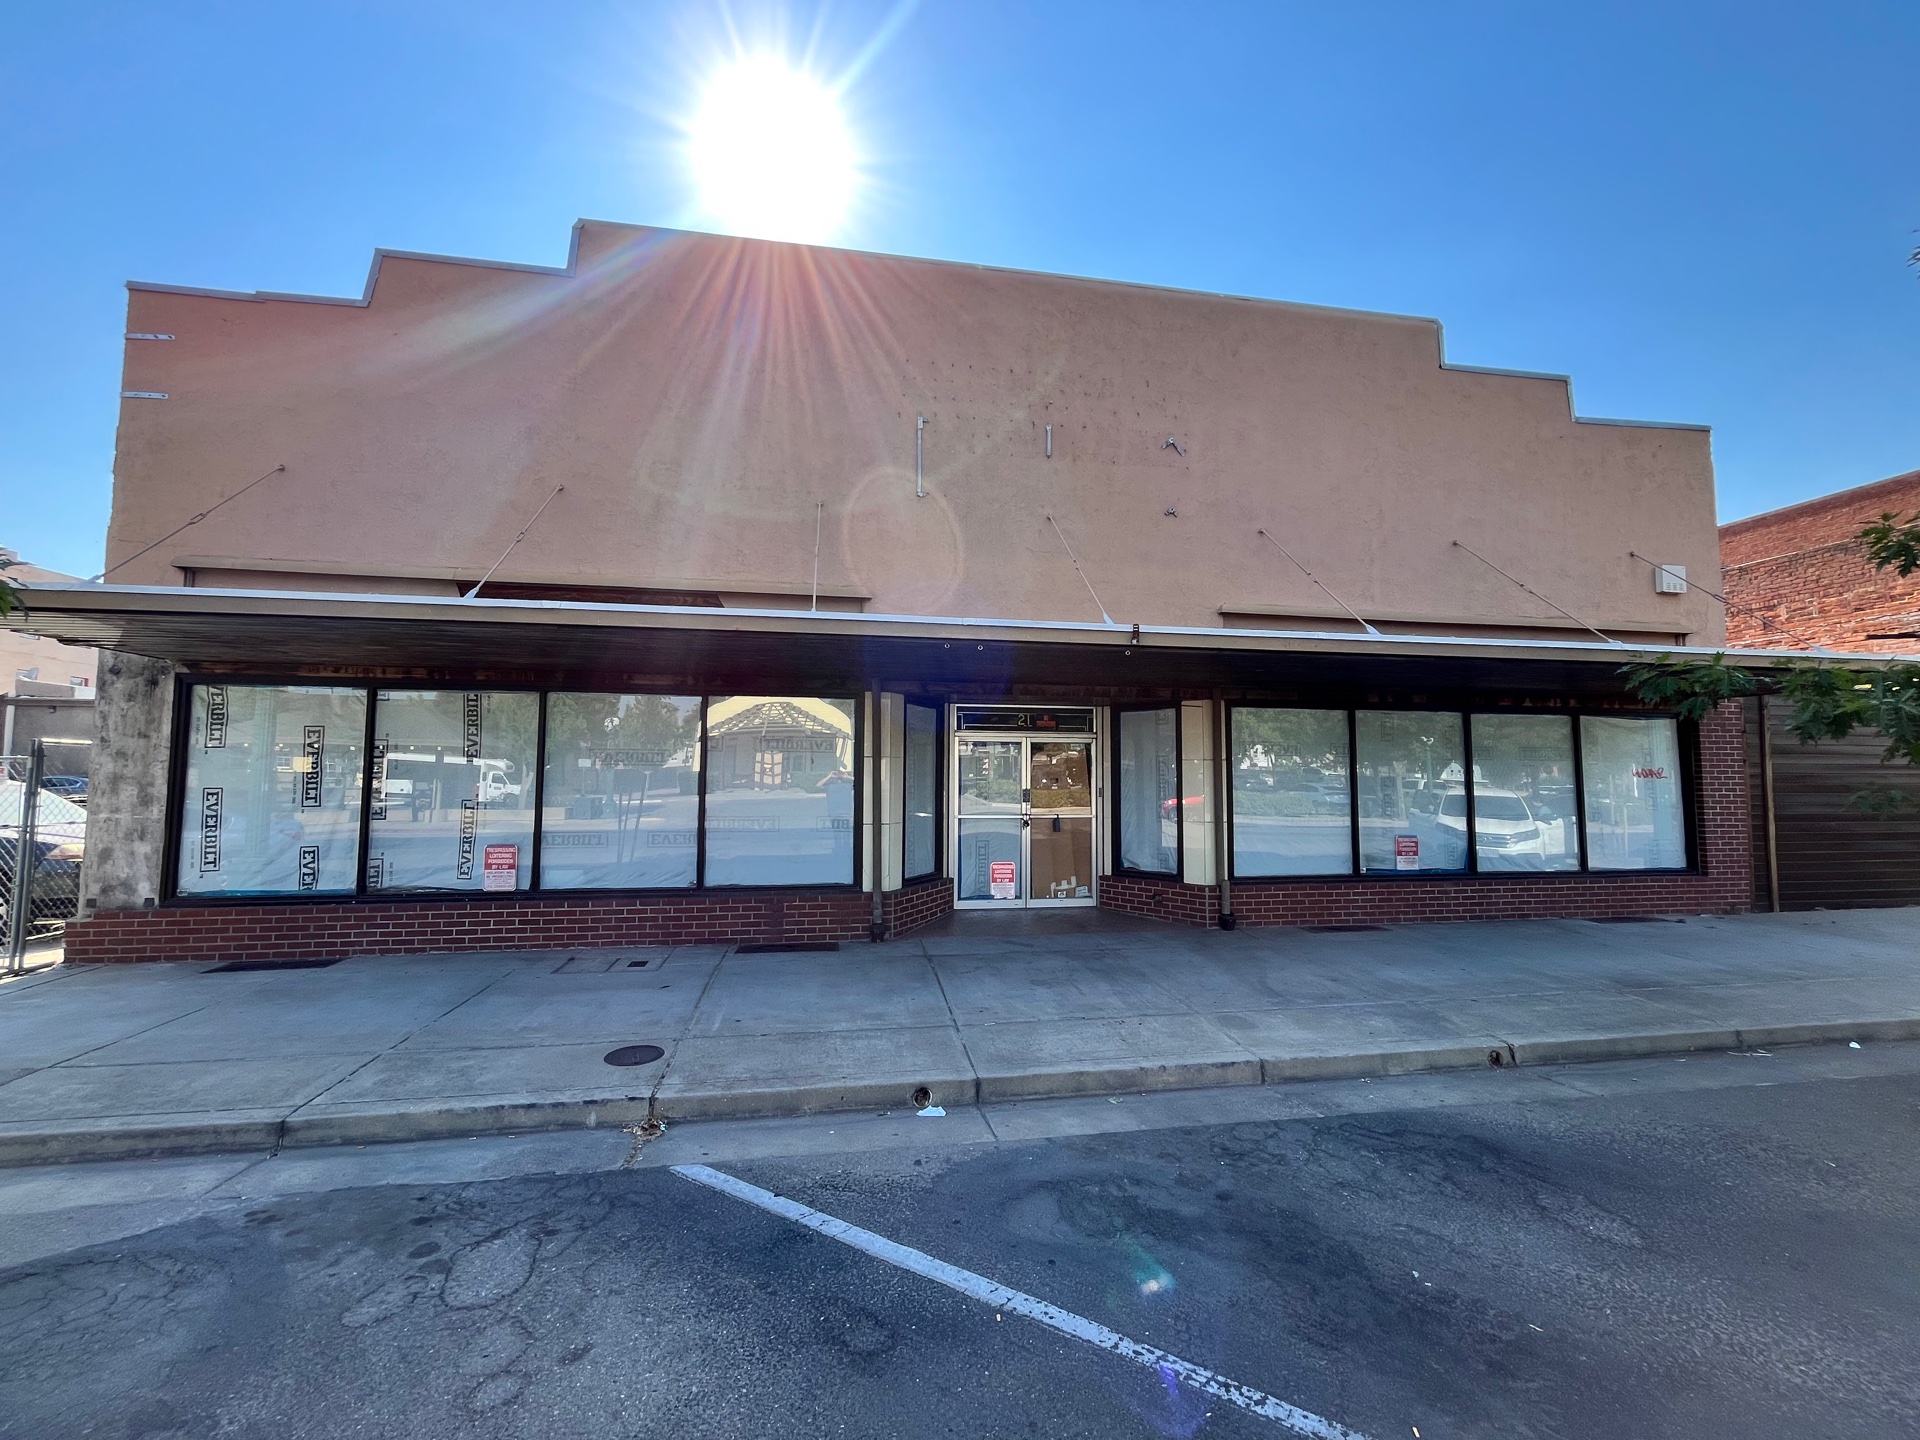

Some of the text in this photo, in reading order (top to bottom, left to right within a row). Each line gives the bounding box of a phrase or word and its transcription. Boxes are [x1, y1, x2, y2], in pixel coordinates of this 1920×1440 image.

[305, 729, 321, 804] EVERBILT
[203, 791, 220, 868] EVERBILT
[460, 803, 475, 876] EVERBILT
